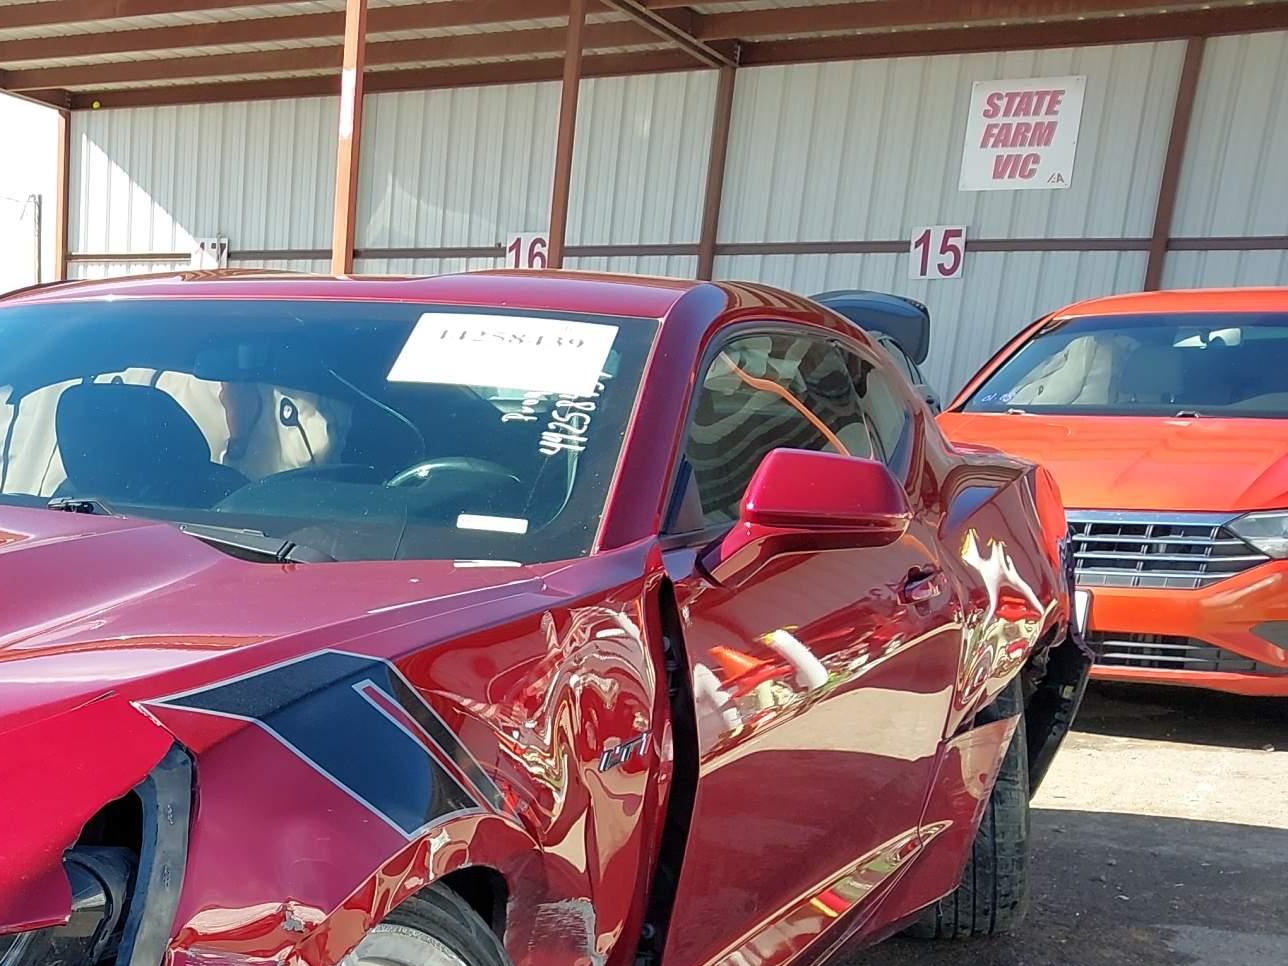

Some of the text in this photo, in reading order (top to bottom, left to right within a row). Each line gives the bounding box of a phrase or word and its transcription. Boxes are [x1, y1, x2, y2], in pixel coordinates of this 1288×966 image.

[983, 90, 1065, 118] STATE
[979, 121, 1058, 149] FARM
[992, 153, 1040, 180] VIC
[508, 237, 547, 269] 16
[914, 229, 962, 276] 15
